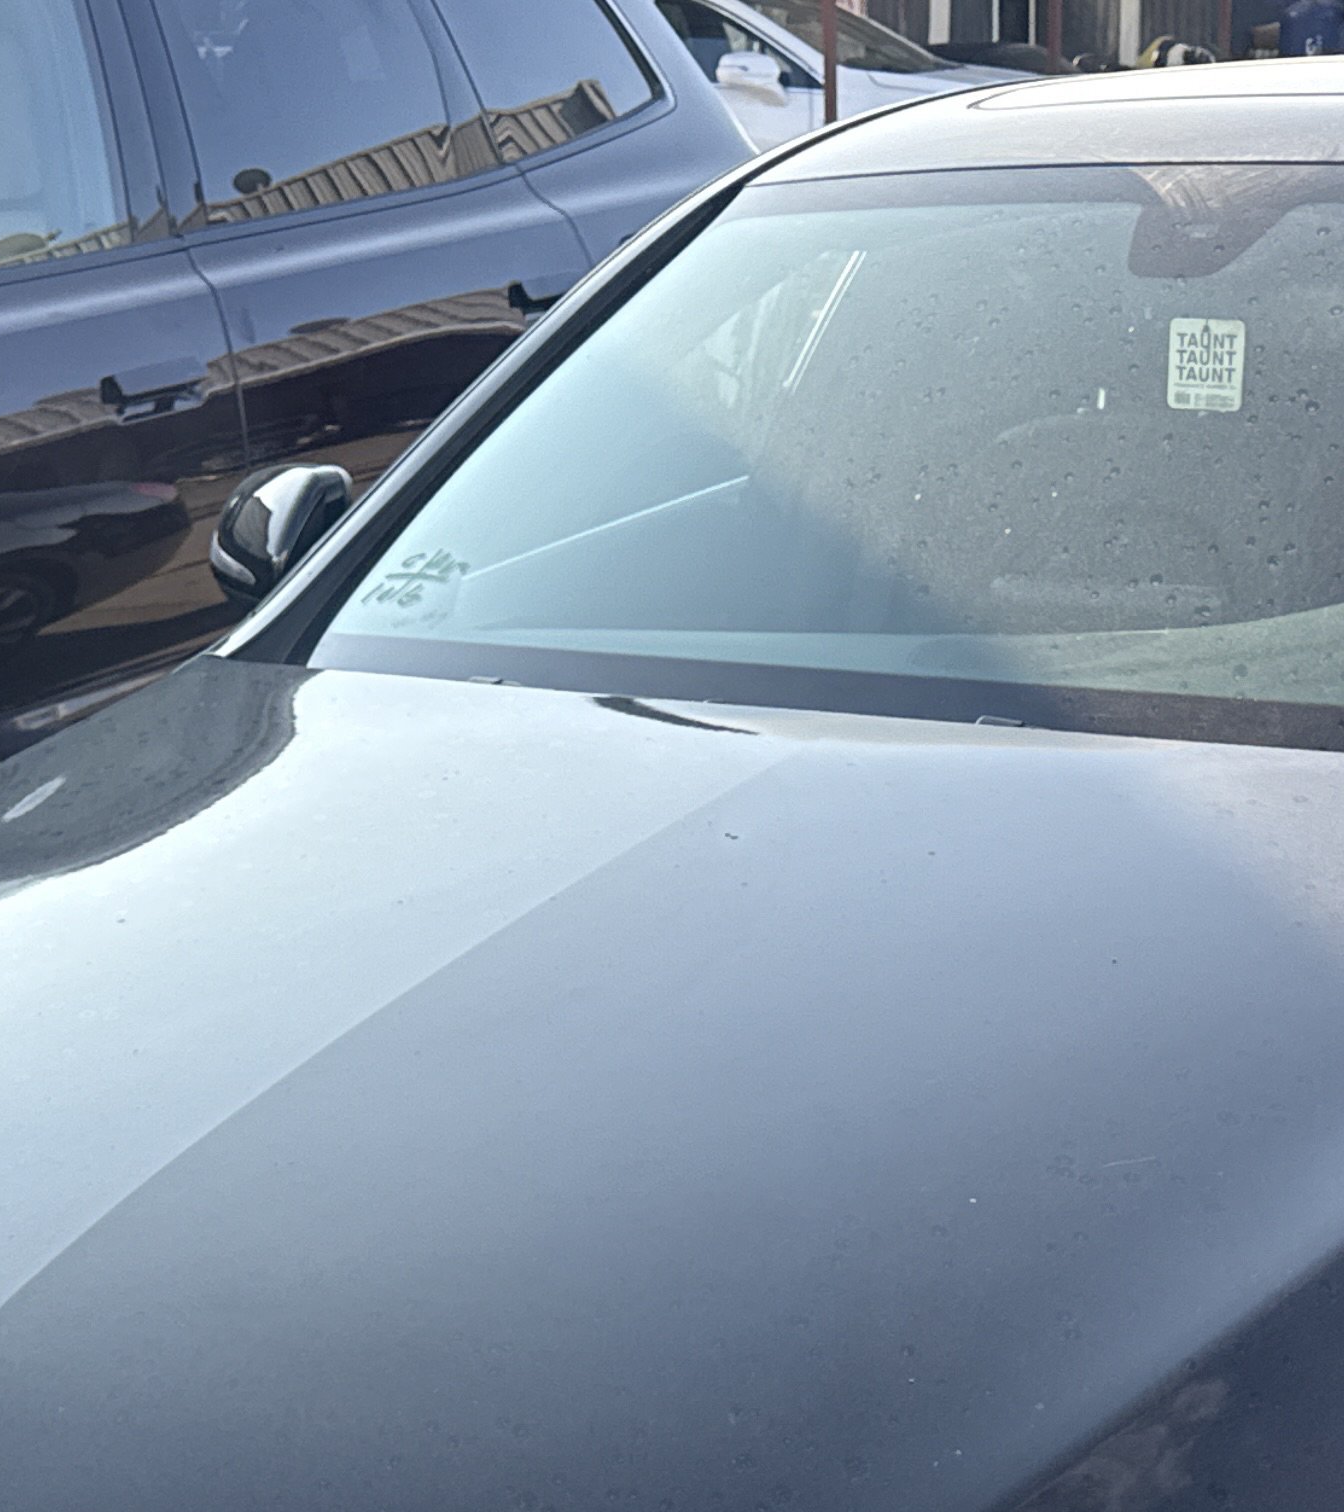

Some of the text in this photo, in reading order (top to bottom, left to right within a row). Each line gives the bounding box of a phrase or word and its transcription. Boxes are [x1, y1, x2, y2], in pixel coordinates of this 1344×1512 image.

[1176, 332, 1237, 350] TAUNT
[1175, 349, 1237, 366] TAUNT
[1175, 365, 1236, 383] TAUNT
